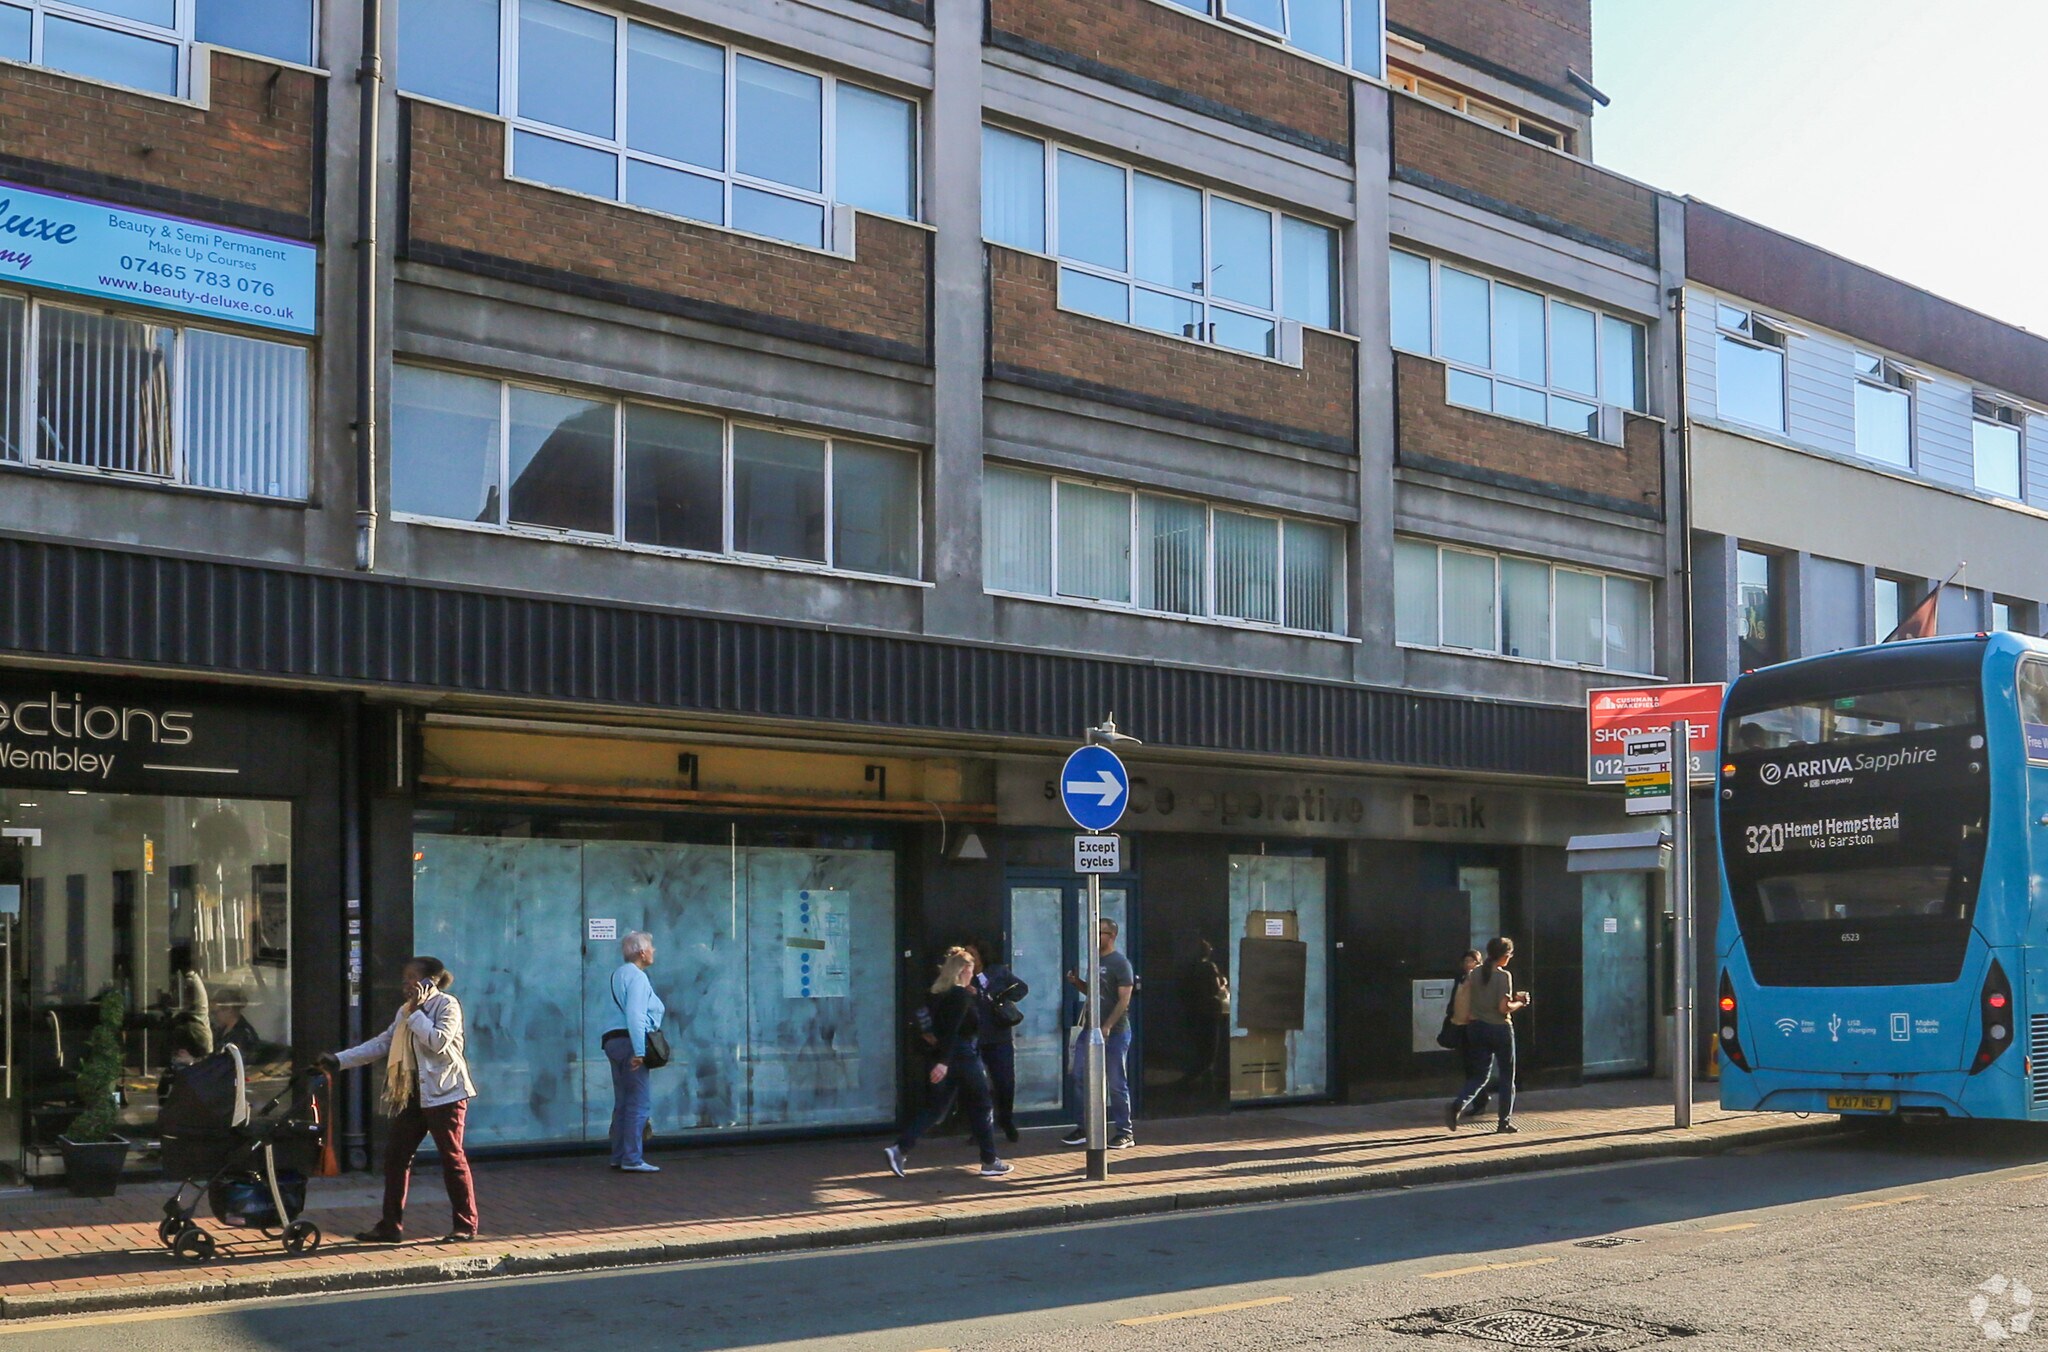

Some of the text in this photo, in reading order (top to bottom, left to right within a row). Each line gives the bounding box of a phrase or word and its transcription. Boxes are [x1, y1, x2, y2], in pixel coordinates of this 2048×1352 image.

[109, 214, 287, 261] Beauty & Semi Permanent
[148, 240, 257, 271] Make Up Courses
[120, 255, 275, 297] 07465 783 076
[98, 275, 294, 319] www.beauty-deluxe.co.uk
[2027, 735, 2042, 748] Free
[1784, 746, 1937, 779] ARRIVA Sapphire
[1821, 777, 1854, 786] company
[1044, 781, 1057, 800] 5
[1413, 793, 1485, 829] Bank
[1746, 813, 1899, 854] 320 Hemel Hempstead
[1829, 834, 1874, 848] Garston
[1079, 841, 1115, 854] Except
[1080, 856, 1114, 870] cycles
[1841, 933, 1860, 942] 6523
[1847, 1027, 1876, 1035] charging
